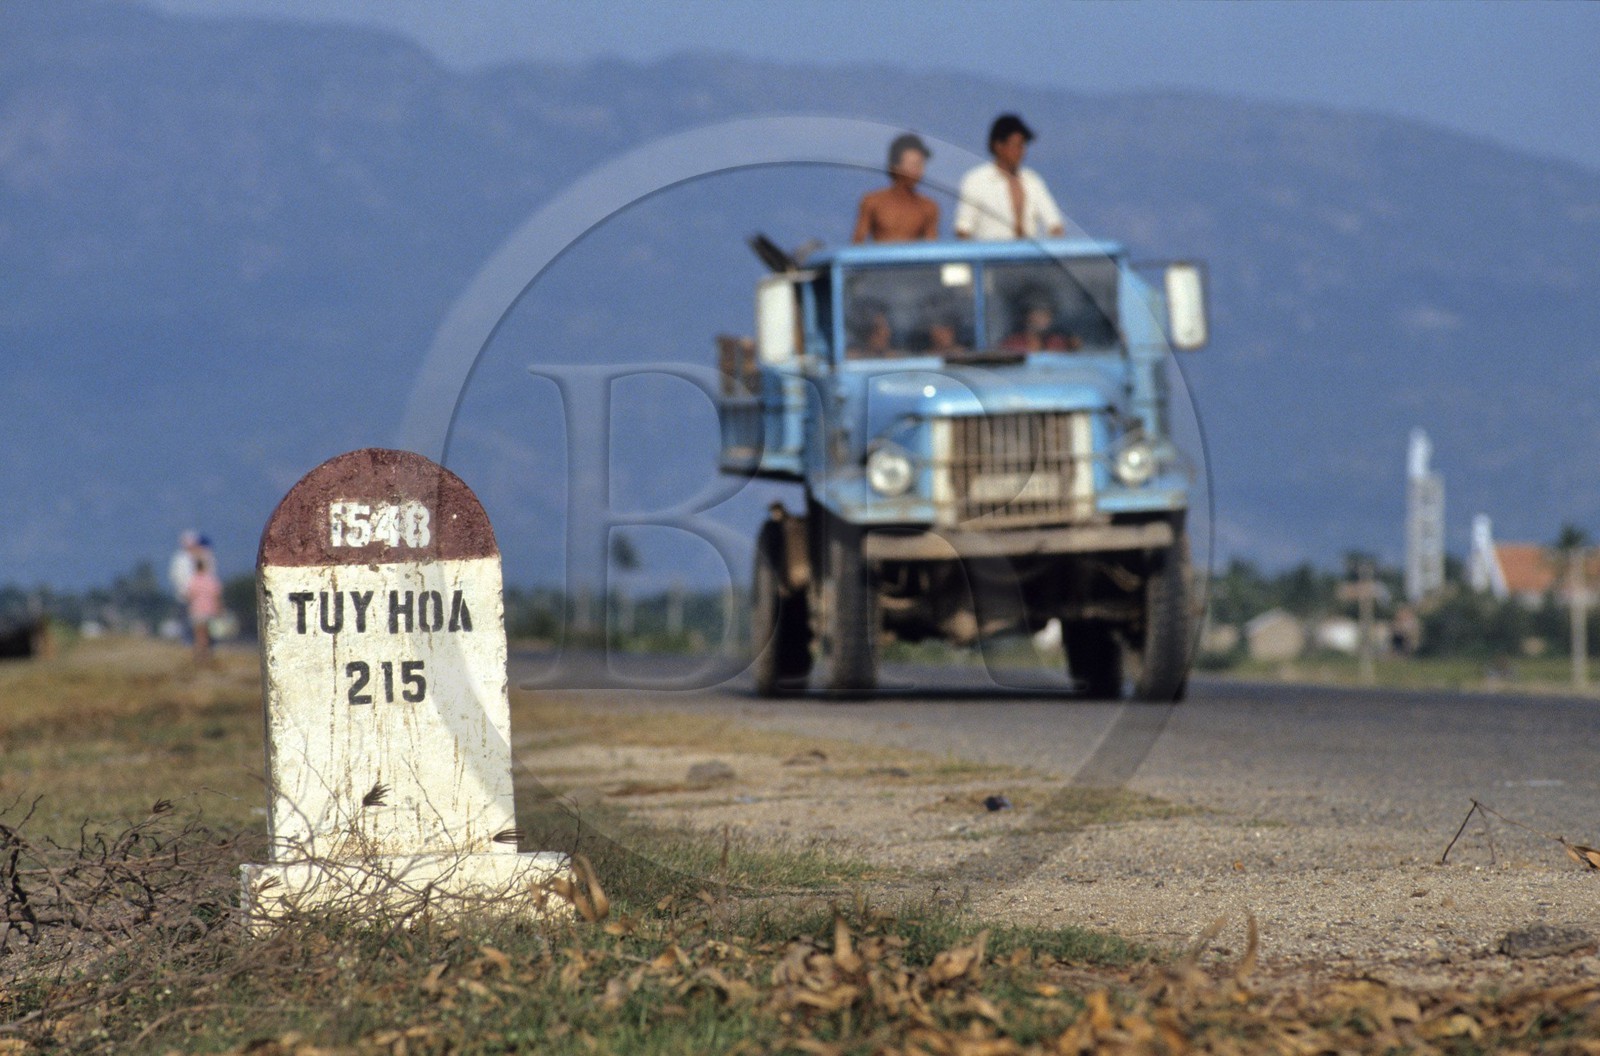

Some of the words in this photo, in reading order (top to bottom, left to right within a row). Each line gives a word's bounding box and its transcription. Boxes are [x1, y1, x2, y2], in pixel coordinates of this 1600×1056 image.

[288, 590, 374, 634] TUY
[389, 590, 473, 634] HOA
[345, 660, 427, 705] 215
